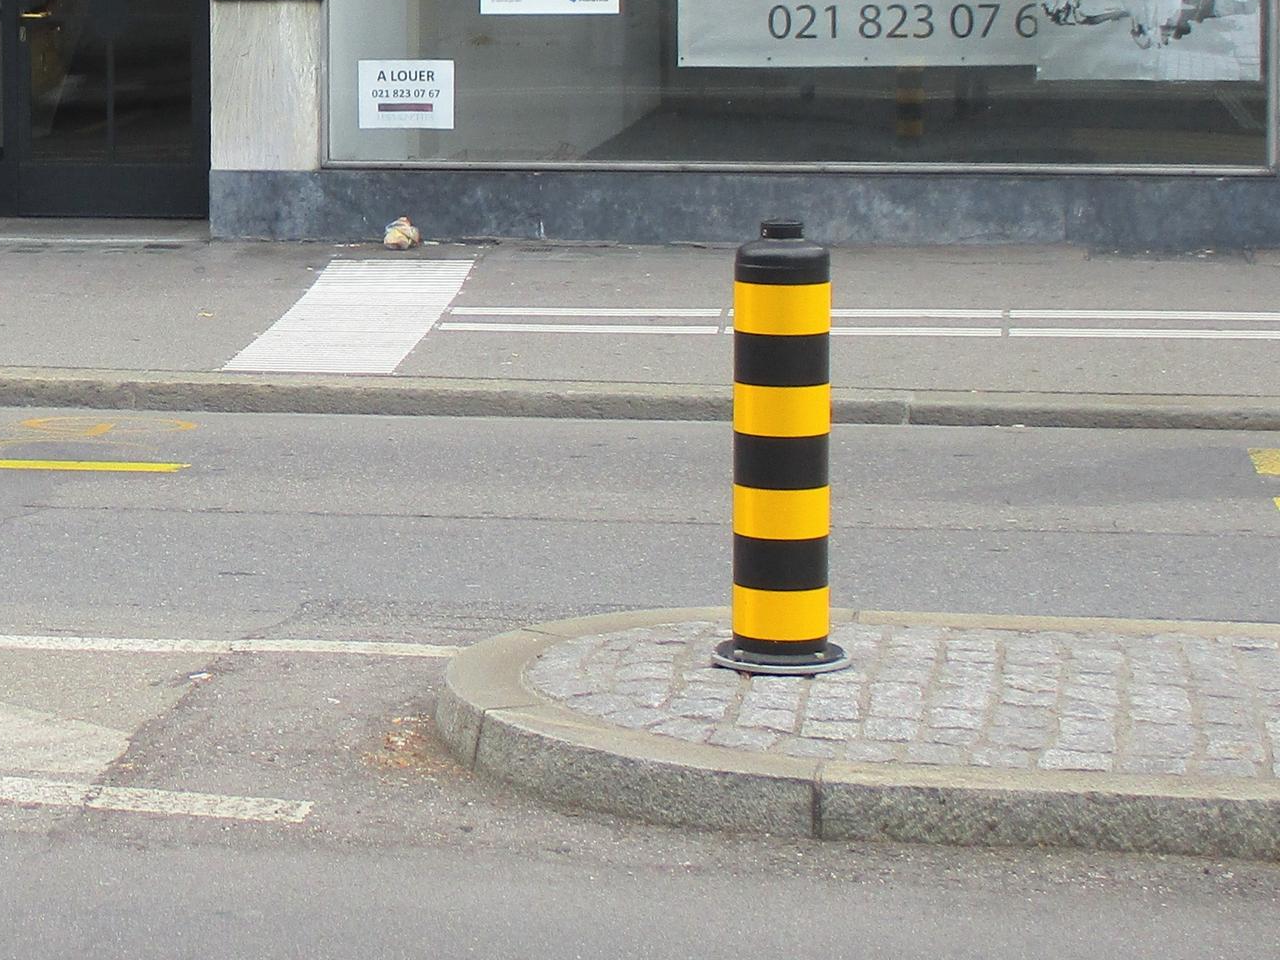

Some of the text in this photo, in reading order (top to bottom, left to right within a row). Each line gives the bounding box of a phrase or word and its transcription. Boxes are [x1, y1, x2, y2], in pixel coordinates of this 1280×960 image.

[767, 3, 1039, 40] 021 823 07 6
[377, 70, 435, 82] A LOUER
[371, 89, 440, 98] 021 823 07 67
